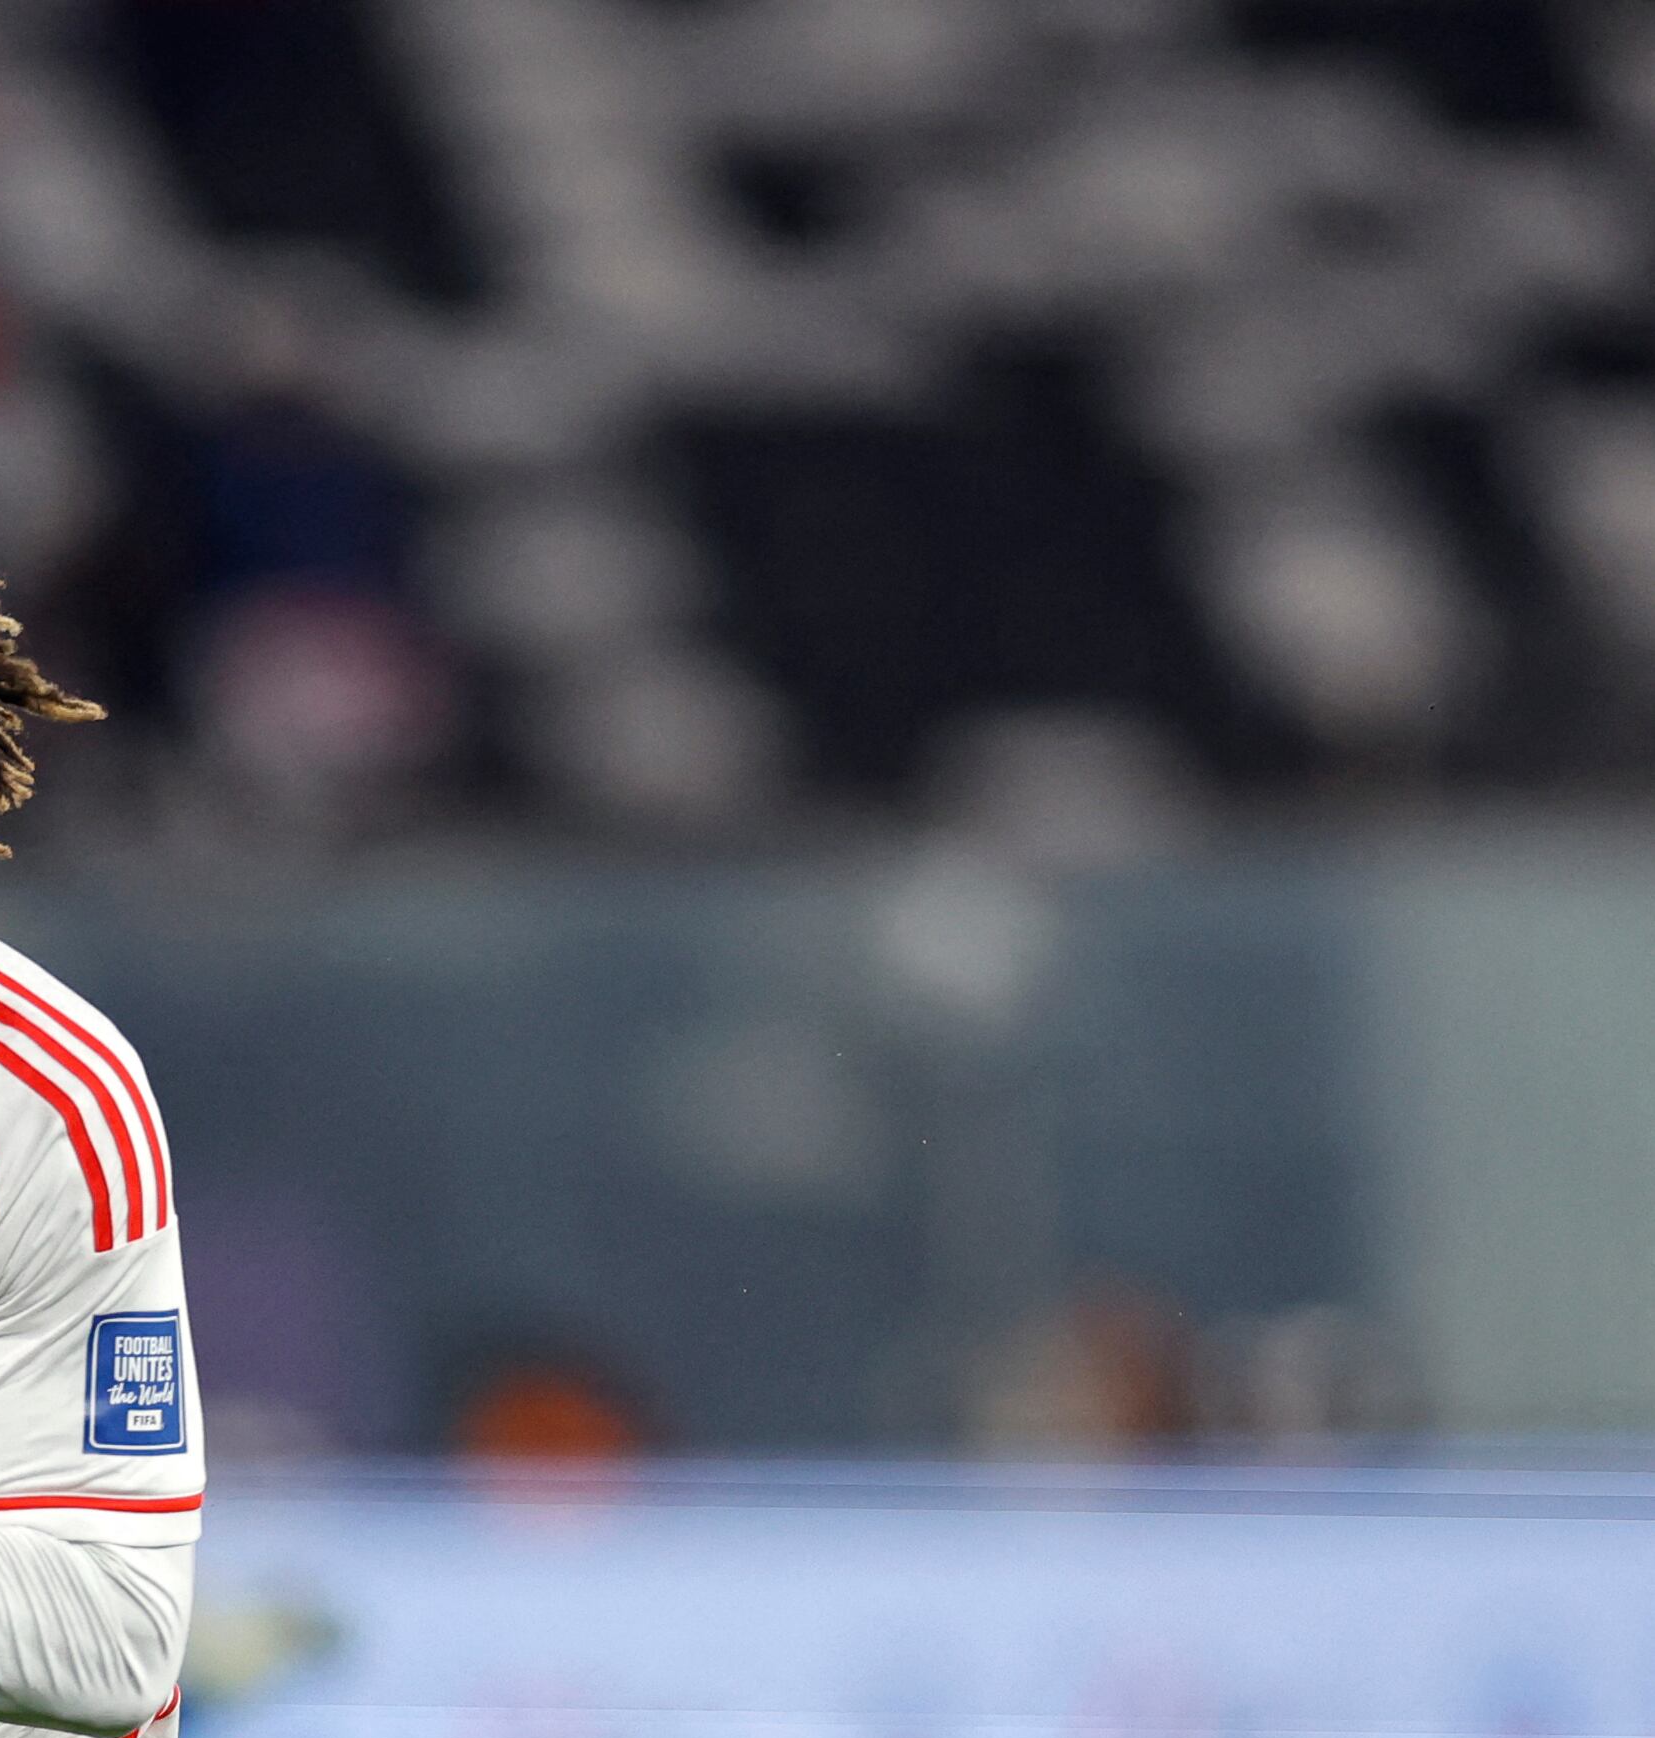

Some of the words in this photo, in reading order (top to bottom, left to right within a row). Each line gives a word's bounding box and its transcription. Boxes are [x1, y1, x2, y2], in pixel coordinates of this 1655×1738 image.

[114, 1335, 174, 1356] FOOTBALL
[113, 1355, 174, 1383] UNITES
[106, 1382, 138, 1405] the
[137, 1381, 176, 1406] World
[132, 1415, 158, 1426] FIFA
